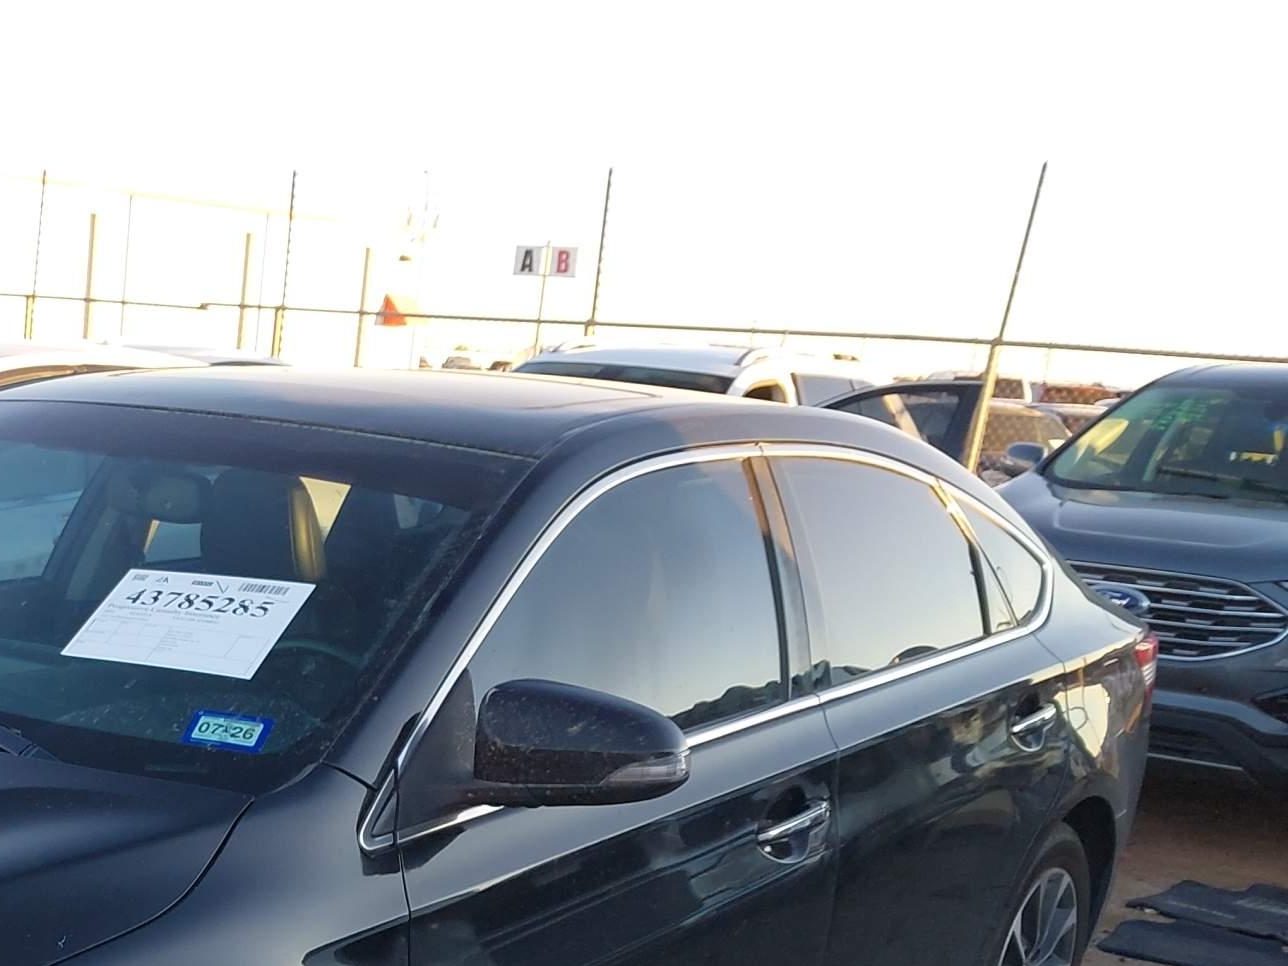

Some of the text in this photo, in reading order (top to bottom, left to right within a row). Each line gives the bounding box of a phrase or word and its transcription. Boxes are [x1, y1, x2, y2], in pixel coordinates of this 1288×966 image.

[520, 248, 569, 273] A B
[125, 588, 275, 618] 43785285
[230, 726, 256, 740] 26
